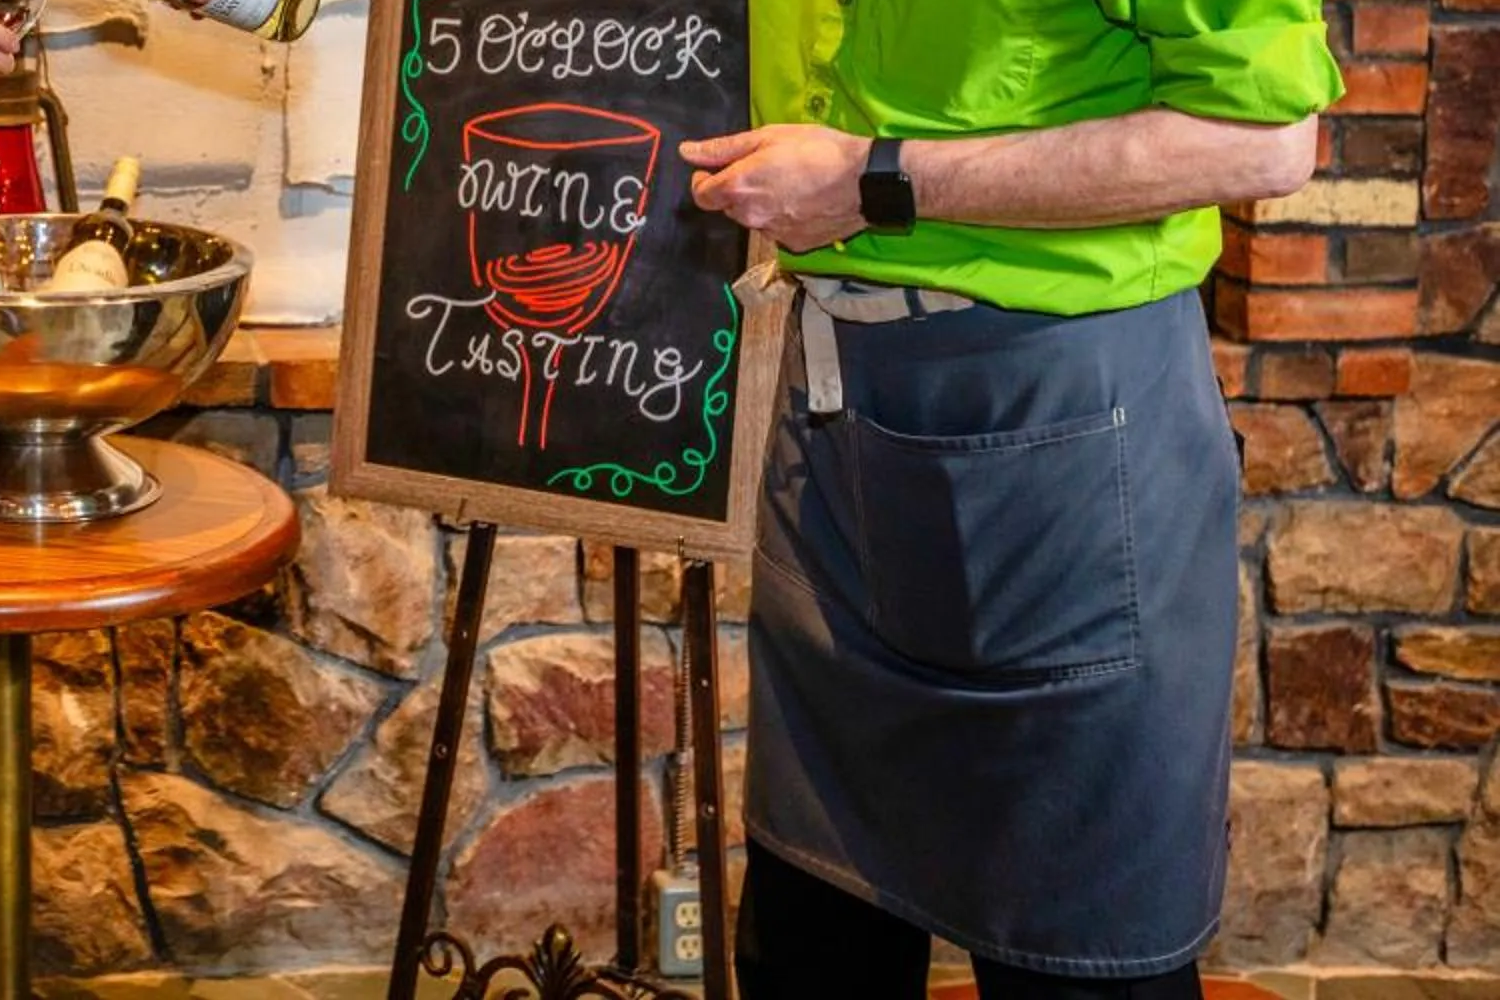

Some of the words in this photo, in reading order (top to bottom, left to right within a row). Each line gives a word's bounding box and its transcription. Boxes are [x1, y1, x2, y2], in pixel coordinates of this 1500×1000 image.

[427, 18, 463, 74] 5
[477, 11, 722, 80] O'CLOCK
[458, 158, 647, 233] WINE
